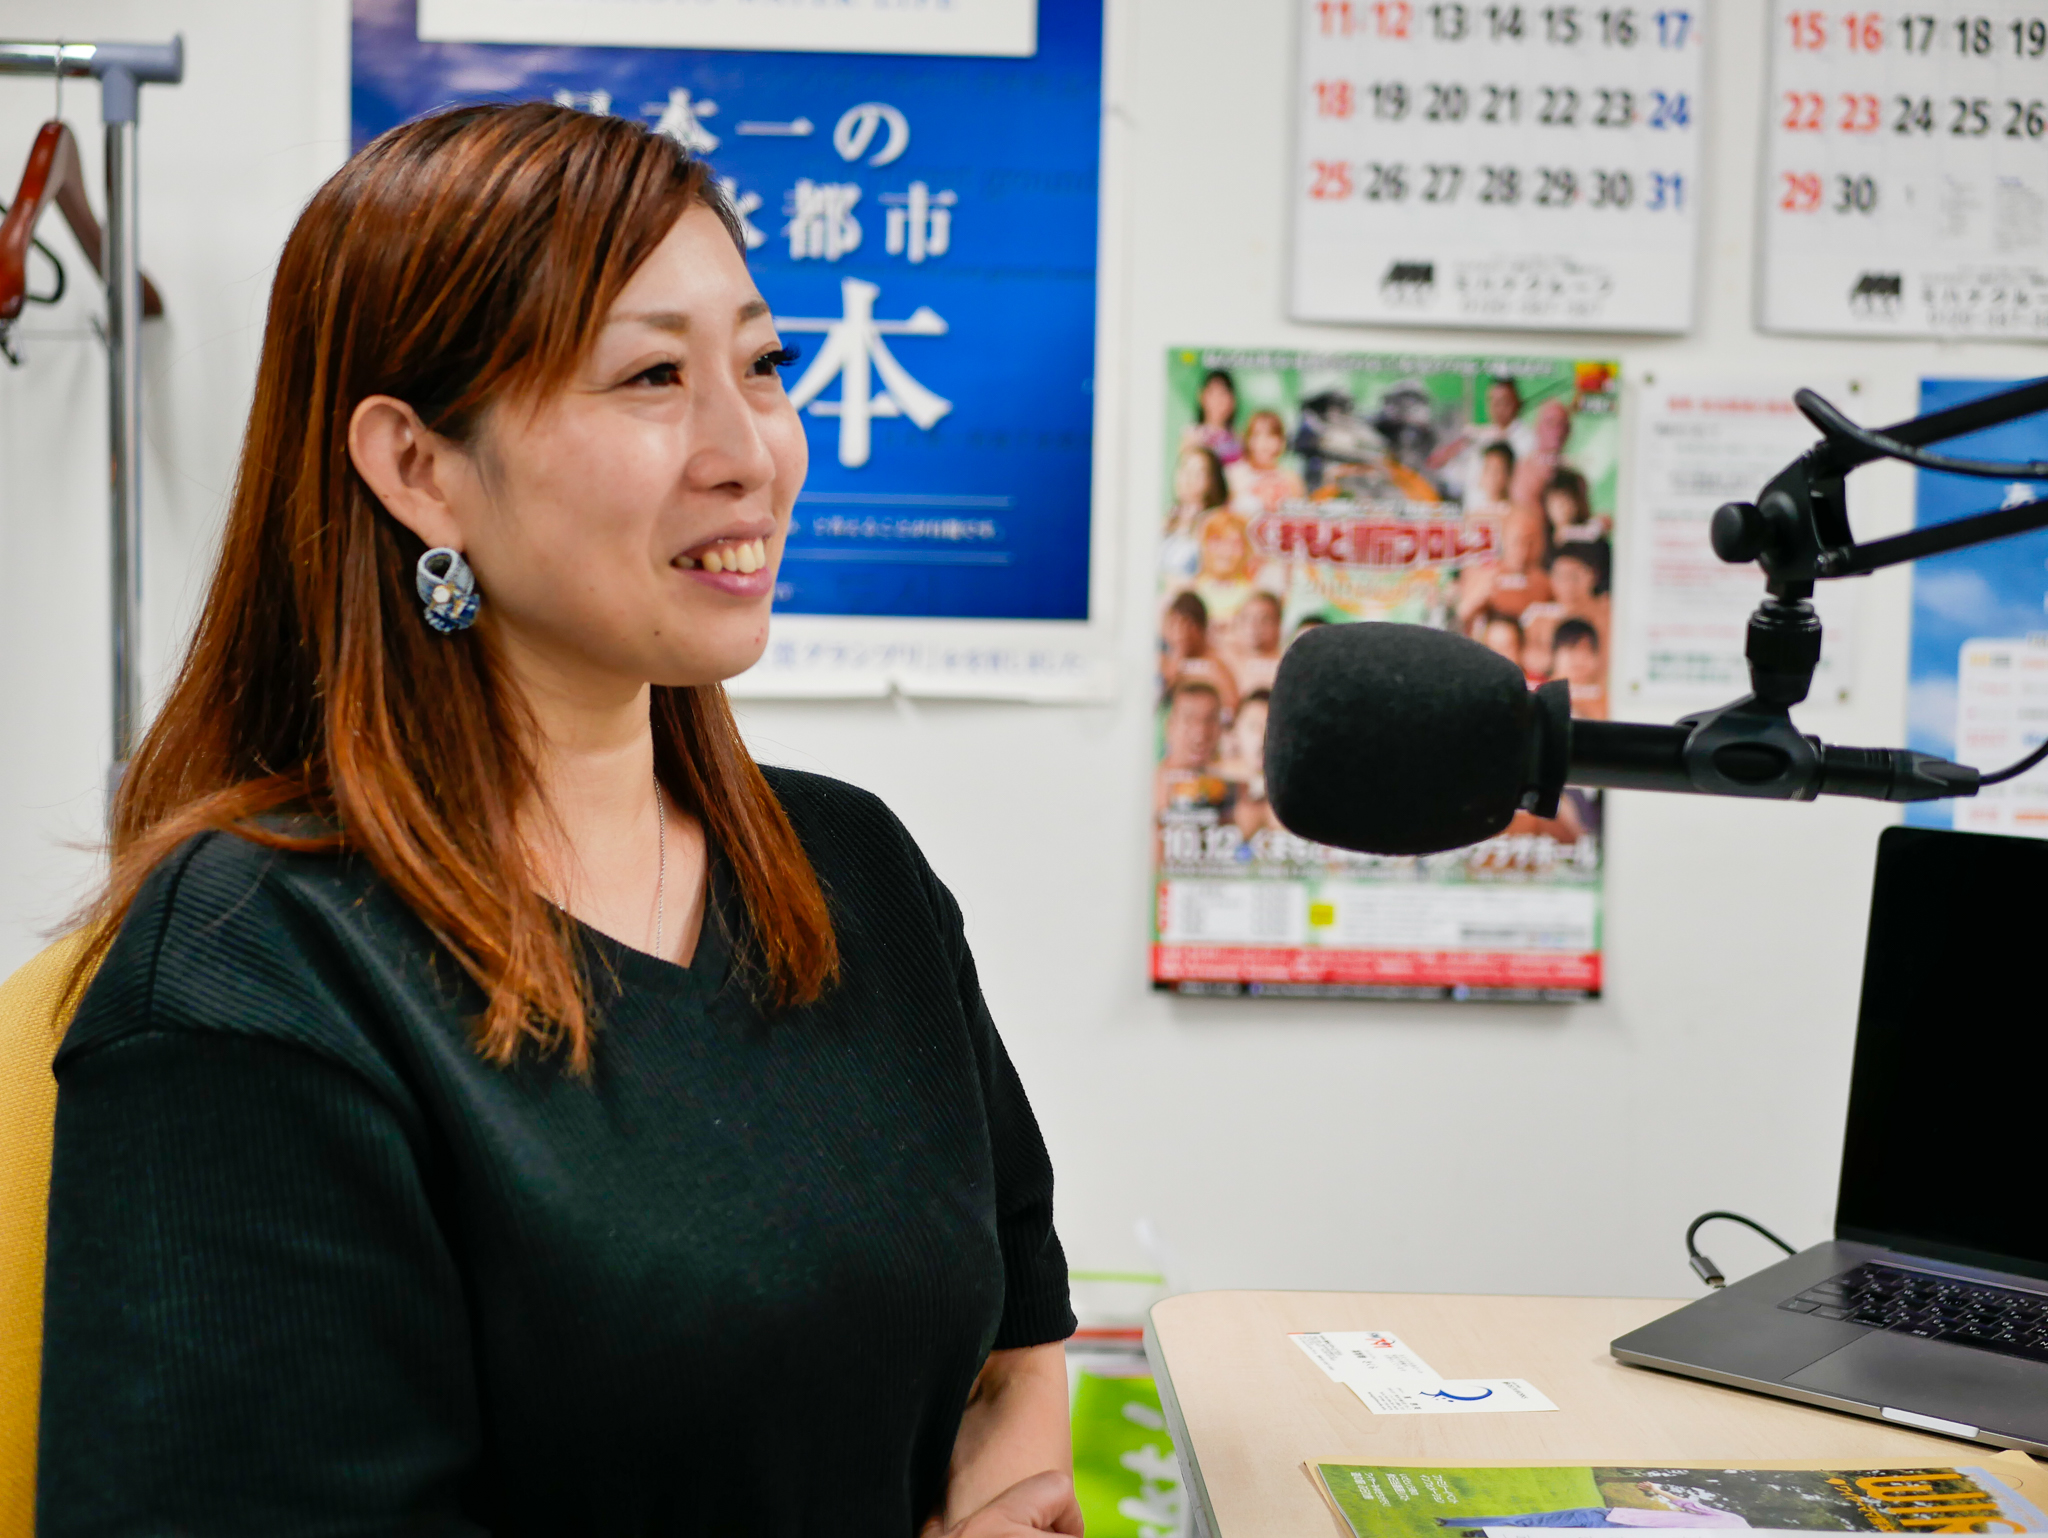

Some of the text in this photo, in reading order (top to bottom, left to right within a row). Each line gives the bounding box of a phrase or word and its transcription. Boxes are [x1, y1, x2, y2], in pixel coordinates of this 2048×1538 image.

[1317, 0, 1692, 47] 11 12 13 14 15 16 17
[1787, 11, 2046, 58] 15 16 17 18 19
[555, 89, 911, 167] 本一の
[1313, 80, 1690, 130] 18 19 20 21 22 23 24
[1783, 92, 2044, 138] 22 23 24 25 26
[1309, 160, 1684, 210] 25 26 27 28 29 30 31
[1780, 172, 1878, 215] 29 30
[772, 277, 954, 469] 本
